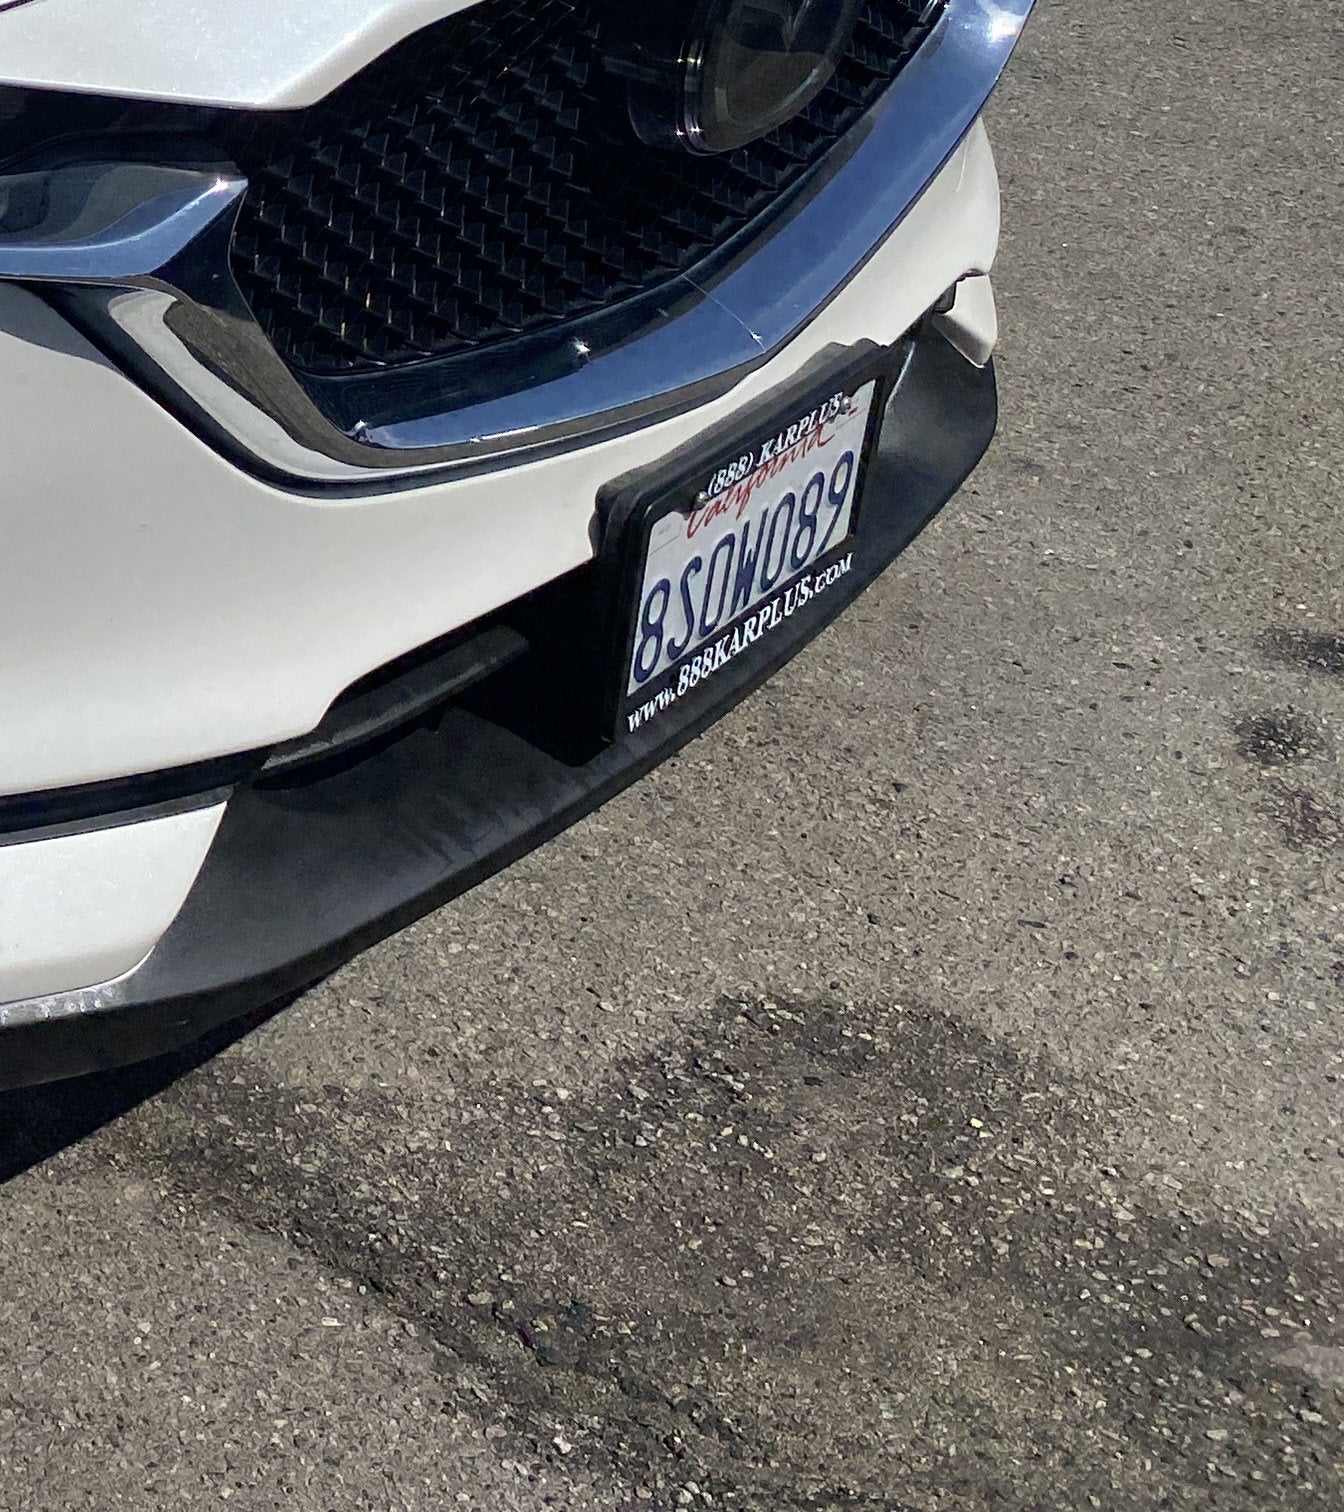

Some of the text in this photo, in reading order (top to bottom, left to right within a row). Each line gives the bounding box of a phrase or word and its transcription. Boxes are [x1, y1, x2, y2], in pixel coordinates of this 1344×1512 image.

[687, 423, 835, 538] California
[708, 391, 844, 497] (888) KARPLUS
[633, 450, 855, 684] 8SOW089
